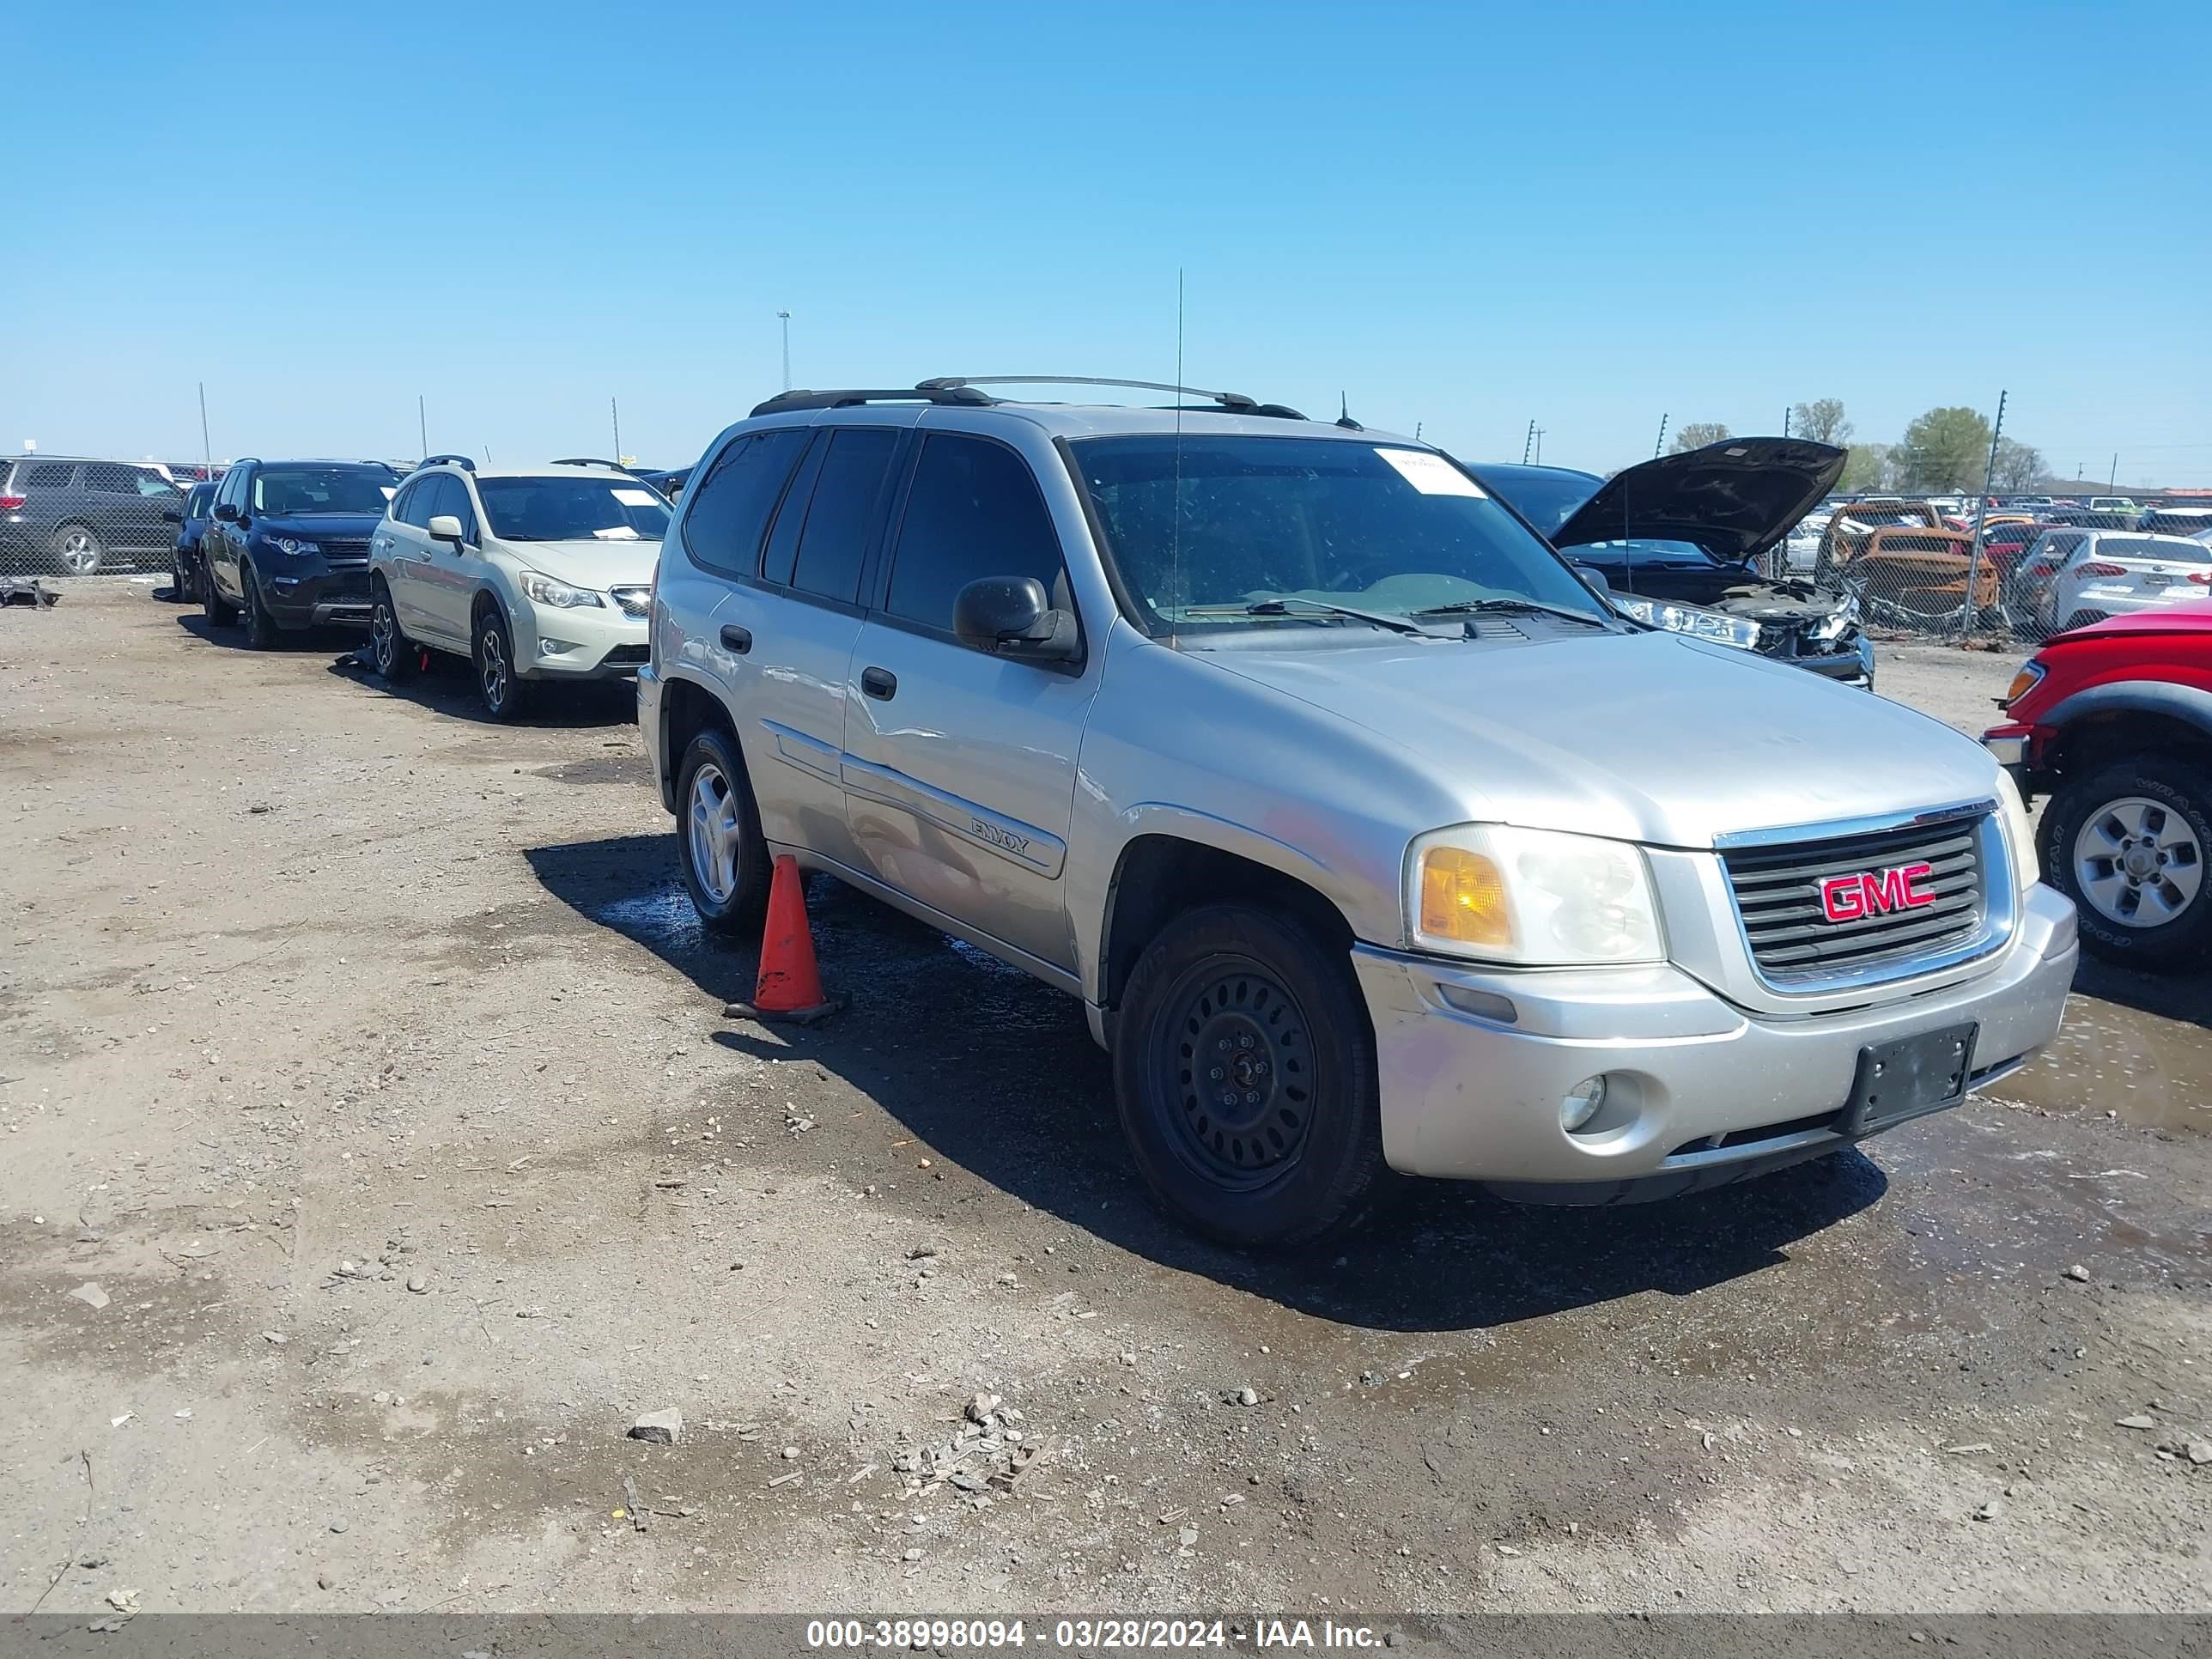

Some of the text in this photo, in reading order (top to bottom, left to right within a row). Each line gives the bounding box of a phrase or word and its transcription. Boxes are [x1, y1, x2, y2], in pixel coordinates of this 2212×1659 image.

[971, 817, 1030, 854] ENVOY
[2136, 777, 2212, 899] WRANG
[1820, 861, 1936, 922] GMC
